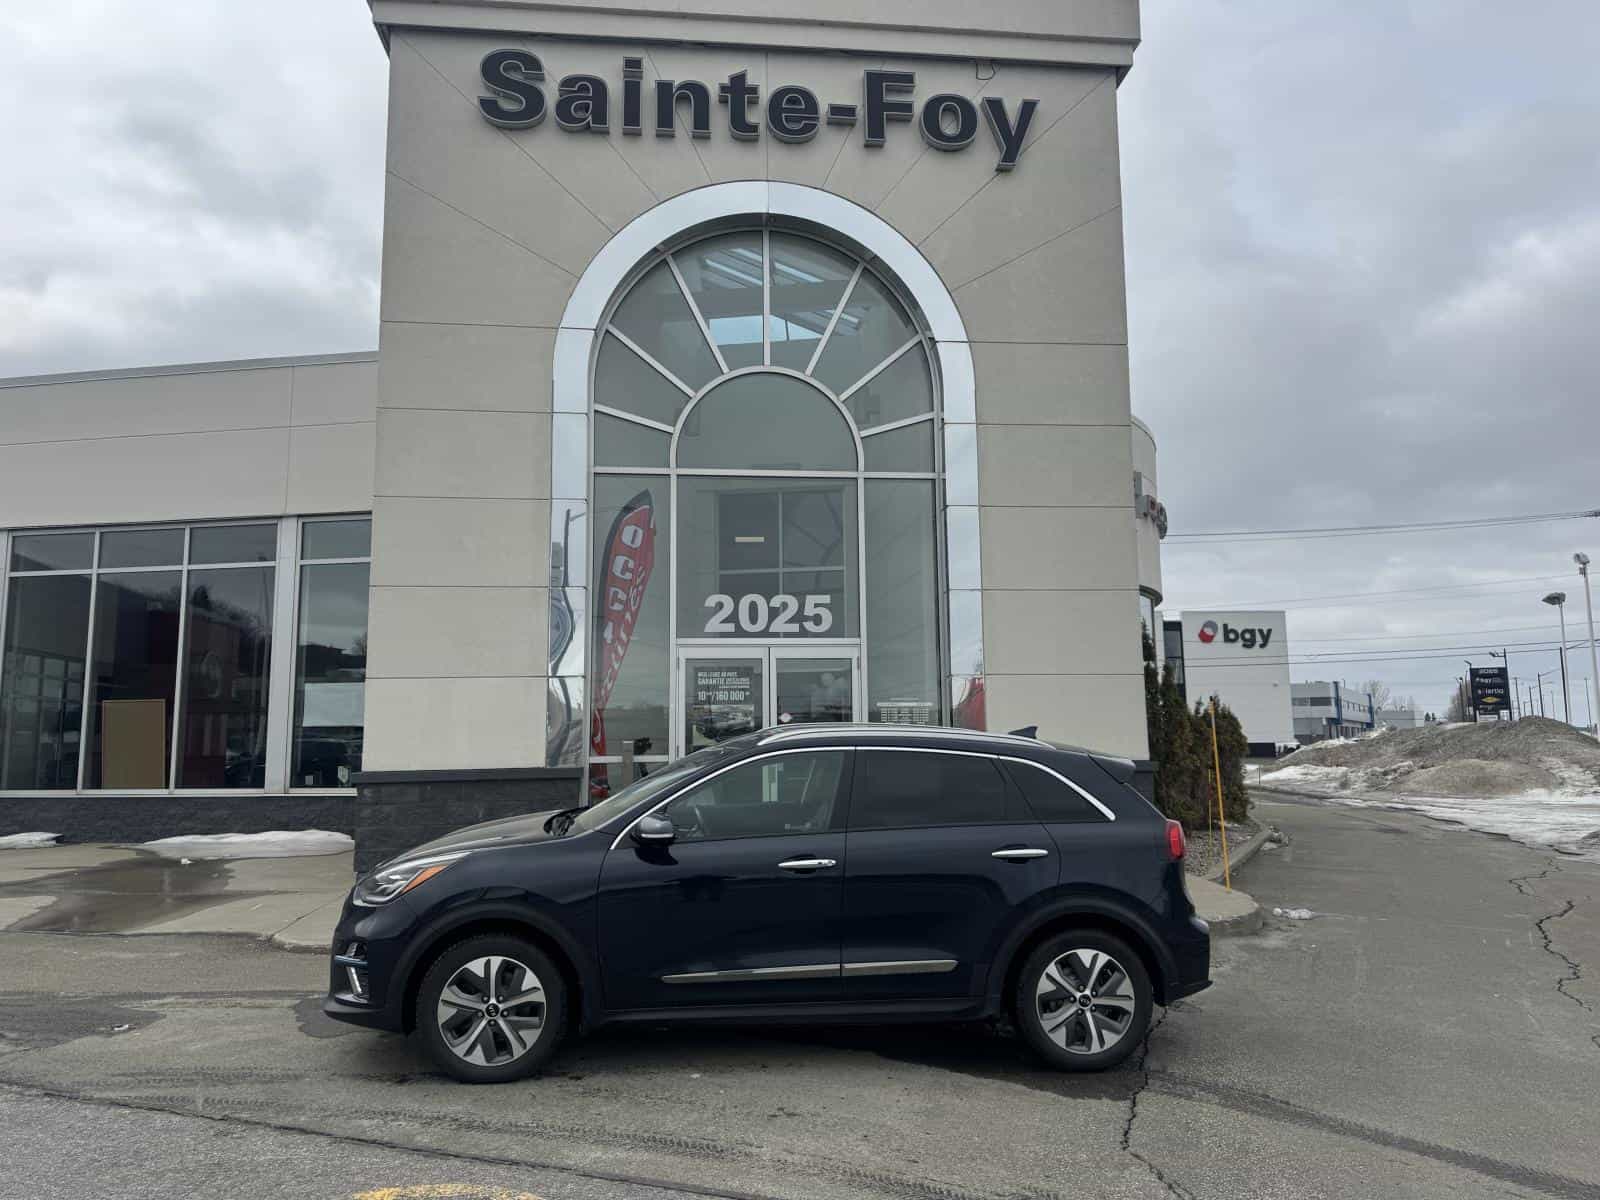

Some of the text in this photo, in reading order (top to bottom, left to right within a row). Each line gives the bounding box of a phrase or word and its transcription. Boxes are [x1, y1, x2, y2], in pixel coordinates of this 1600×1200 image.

[477, 48, 1040, 172] Sainte-Foy
[704, 593, 833, 633] 2025
[1223, 623, 1273, 649] bgy
